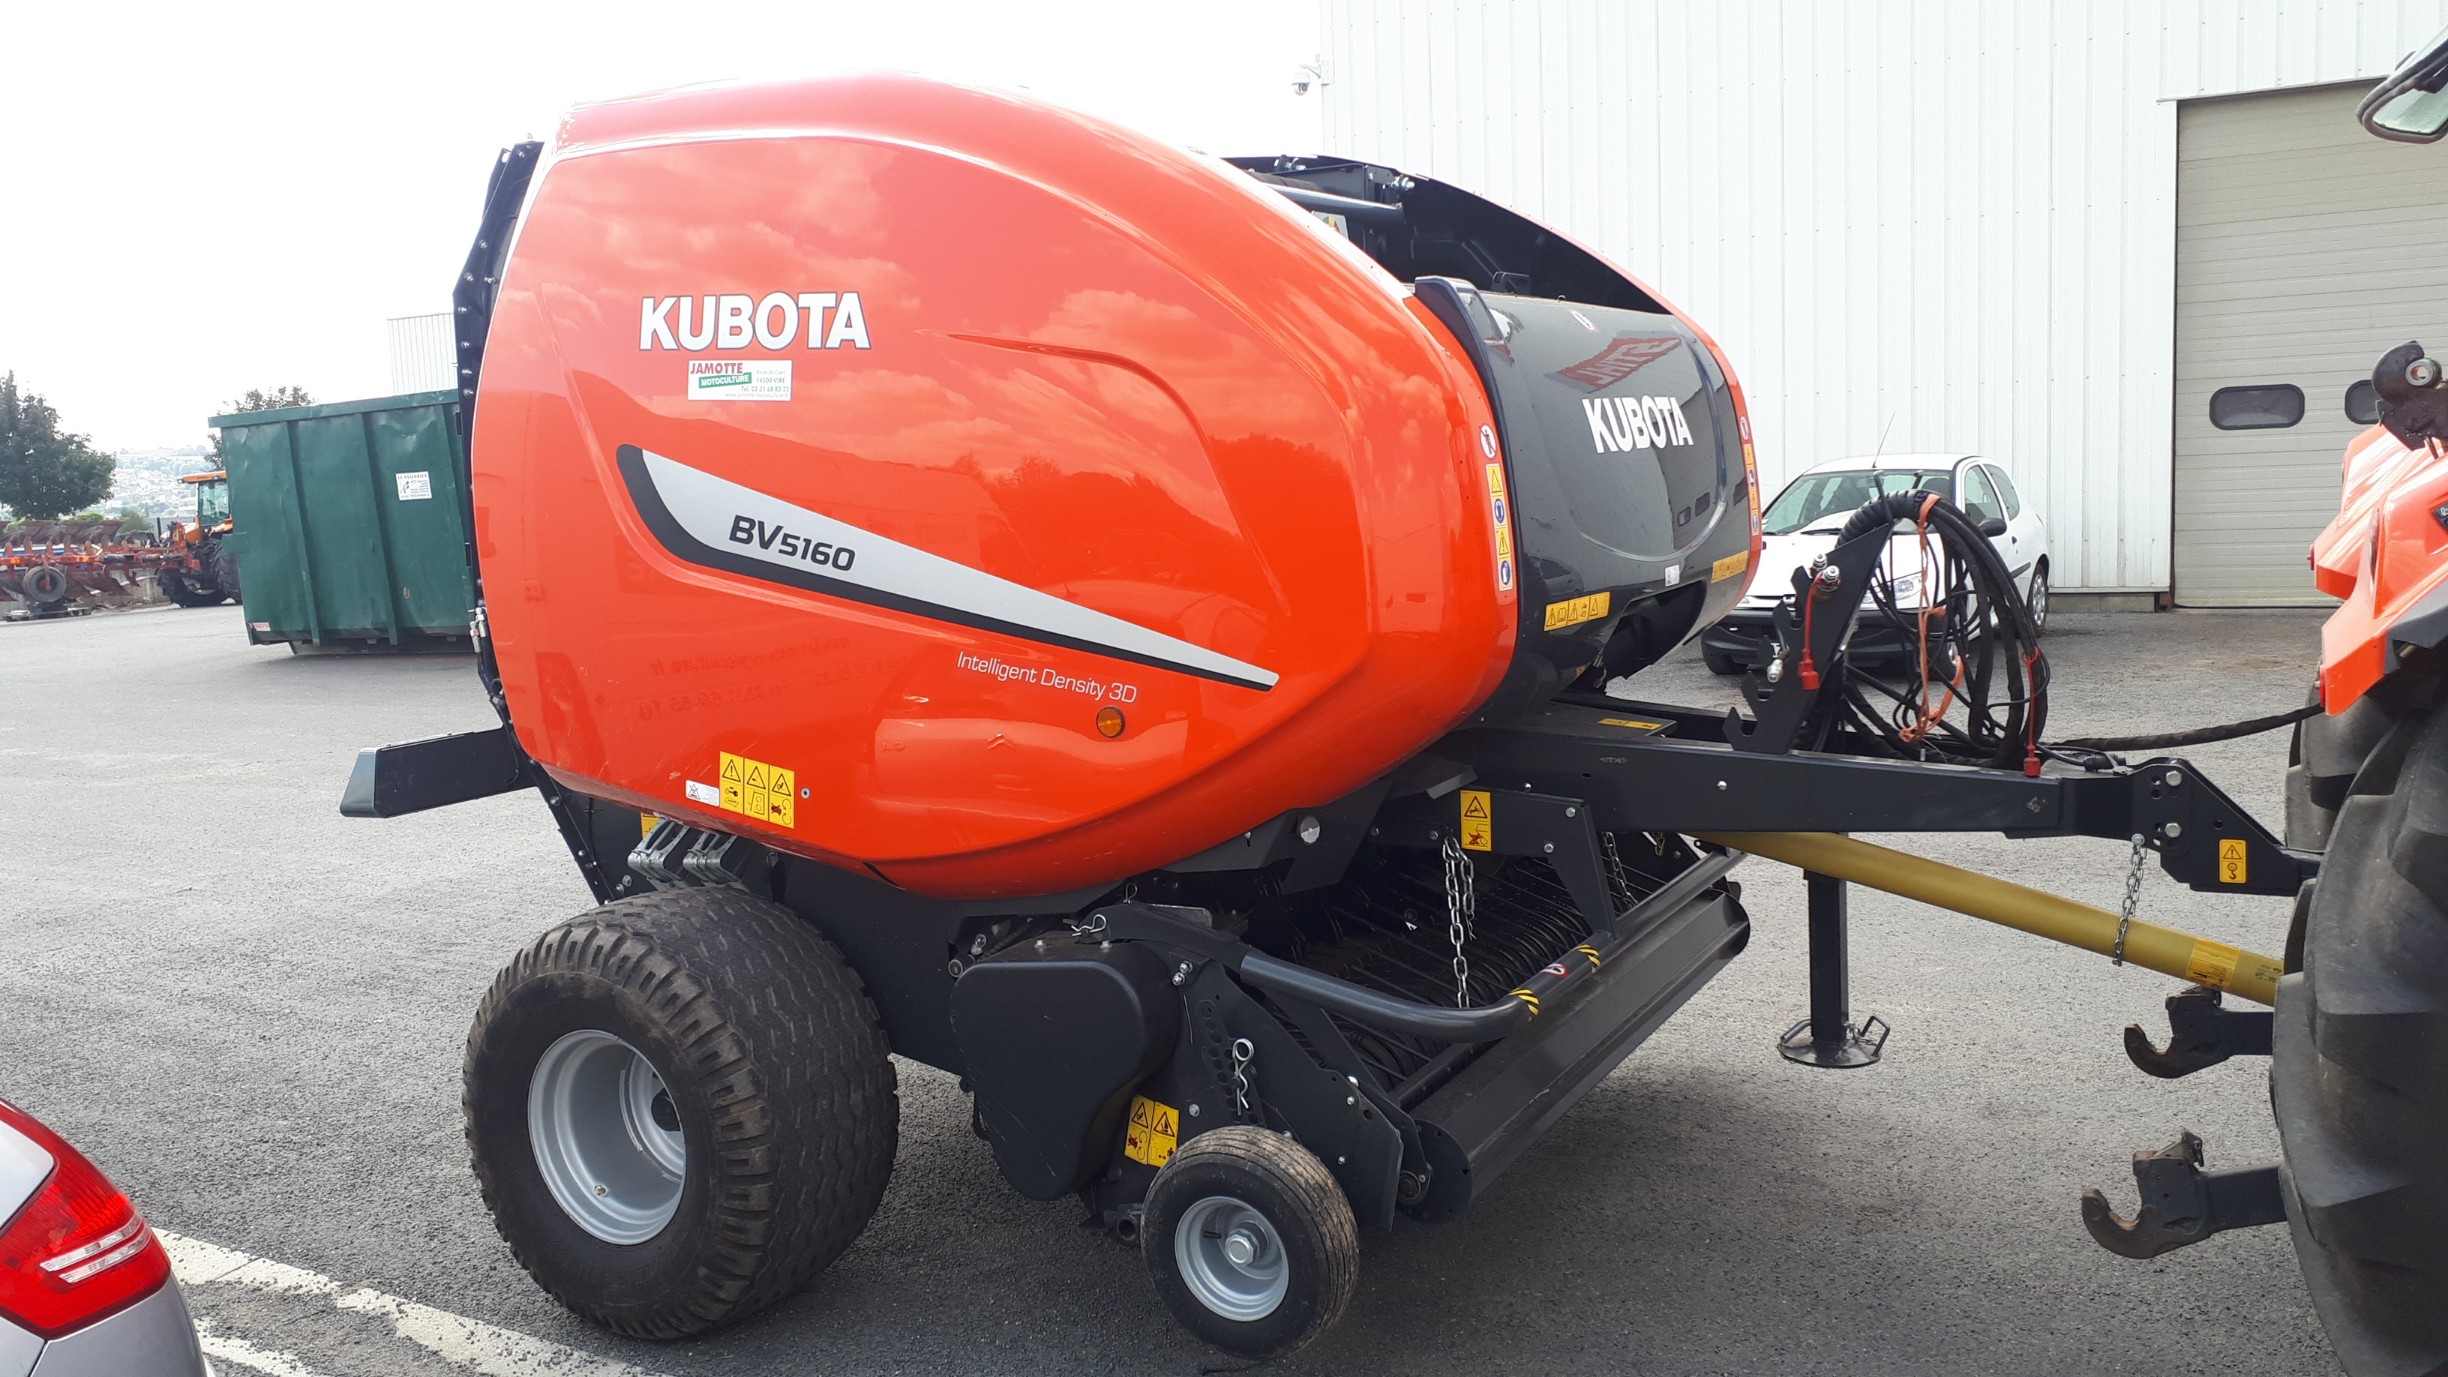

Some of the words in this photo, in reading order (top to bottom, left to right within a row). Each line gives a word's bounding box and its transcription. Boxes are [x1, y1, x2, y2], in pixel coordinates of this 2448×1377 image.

[639, 290, 871, 351] KUBOTA
[691, 362, 743, 374] JAMOTTE
[701, 374, 750, 386] MOTOCULTURE
[1582, 395, 1694, 454] KUBOTA
[729, 514, 856, 572] BV5160
[957, 651, 1038, 682] Intelligent
[1040, 668, 1107, 701] Density
[1108, 682, 1138, 703] 3D
